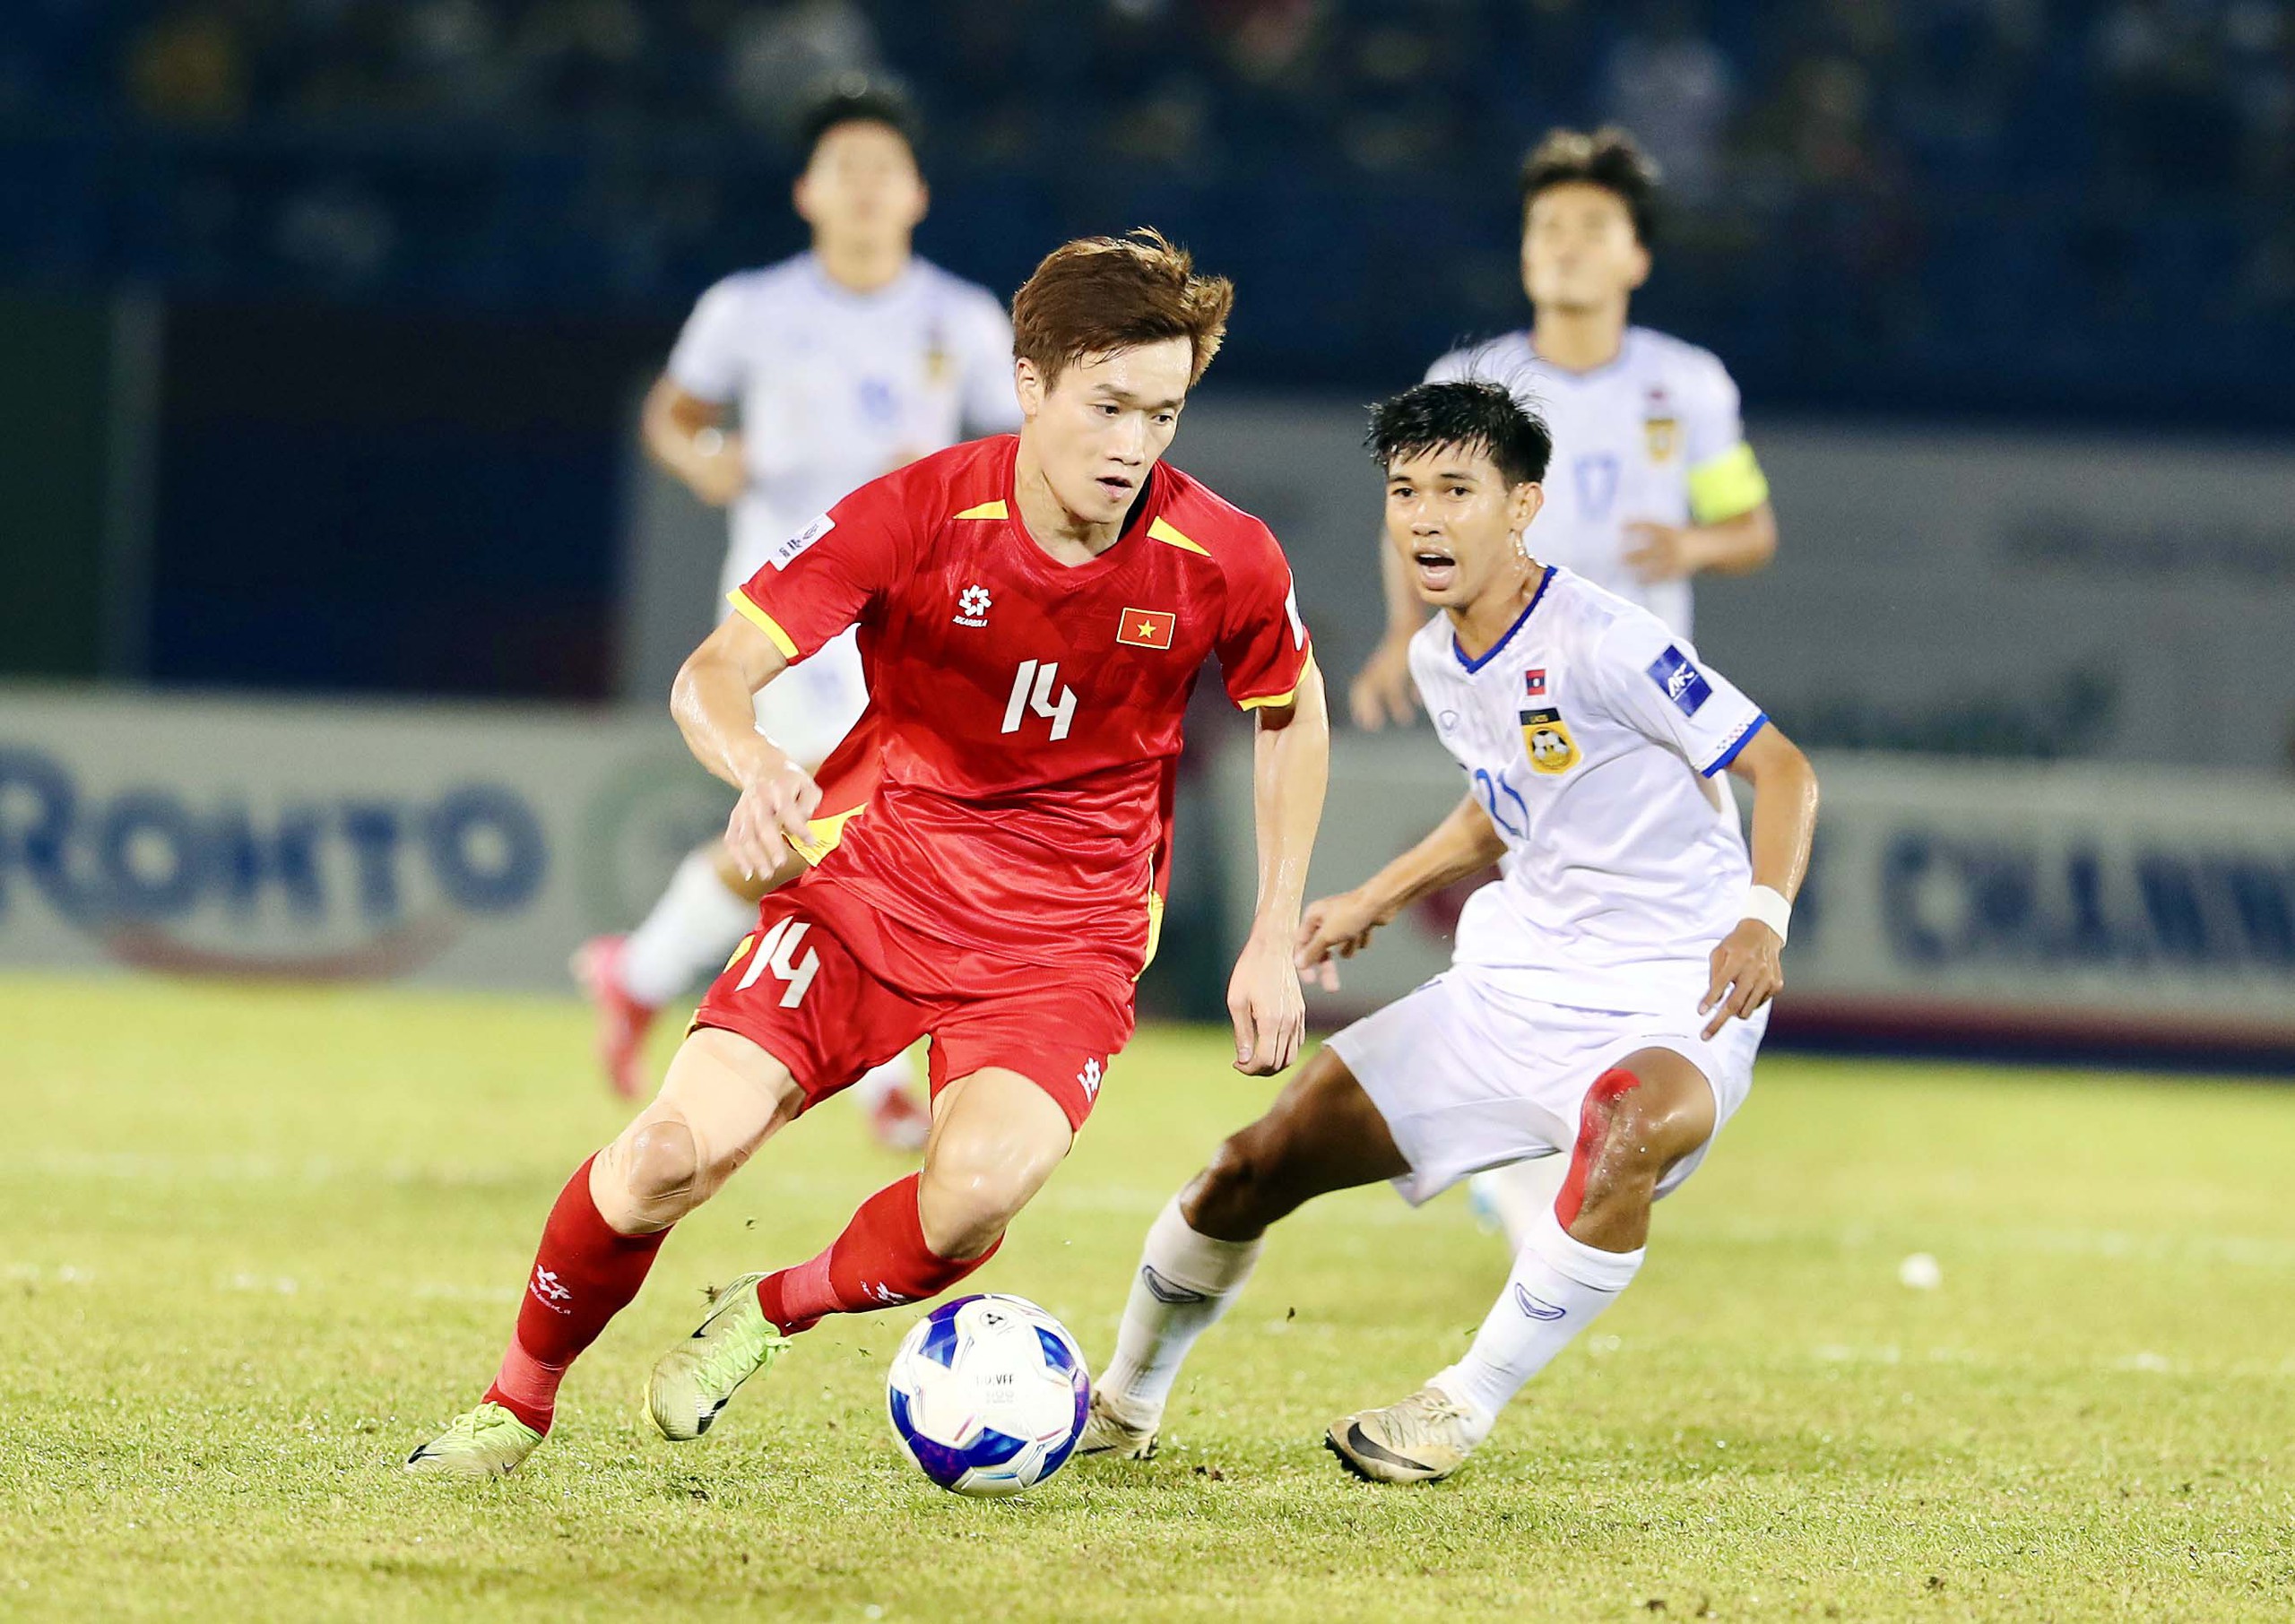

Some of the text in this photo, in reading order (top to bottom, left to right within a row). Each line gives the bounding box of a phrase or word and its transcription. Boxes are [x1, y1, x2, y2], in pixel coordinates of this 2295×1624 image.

[1001, 659, 1078, 741] 14
[1668, 661, 1695, 698] AFC
[734, 915, 821, 1009] 14
